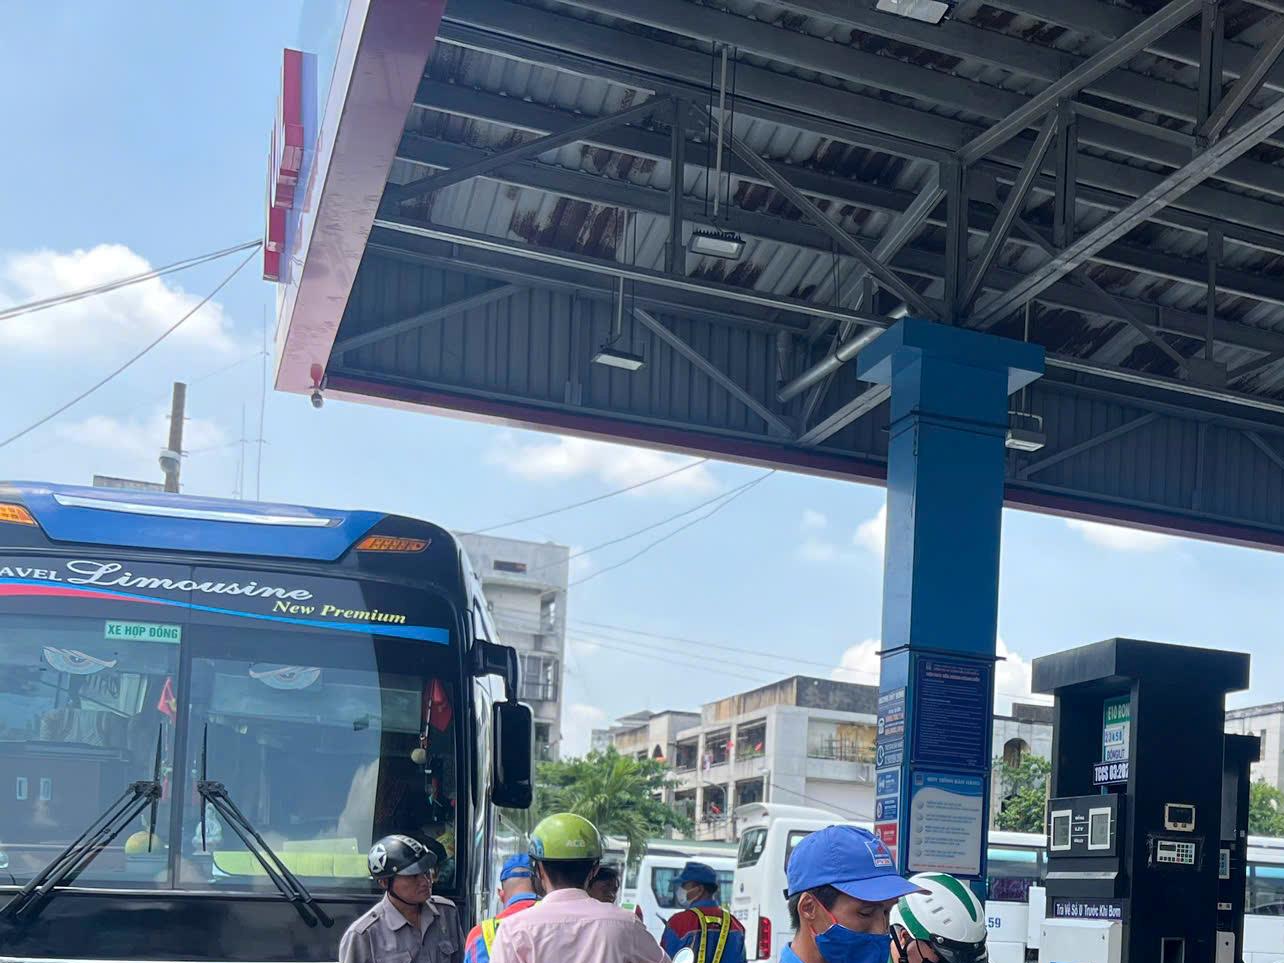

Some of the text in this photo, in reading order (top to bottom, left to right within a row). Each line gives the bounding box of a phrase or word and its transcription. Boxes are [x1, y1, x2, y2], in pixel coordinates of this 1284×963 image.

[0, 560, 313, 600] AVEL Limousine
[272, 600, 406, 624] New Premium
[107, 625, 122, 636] XE
